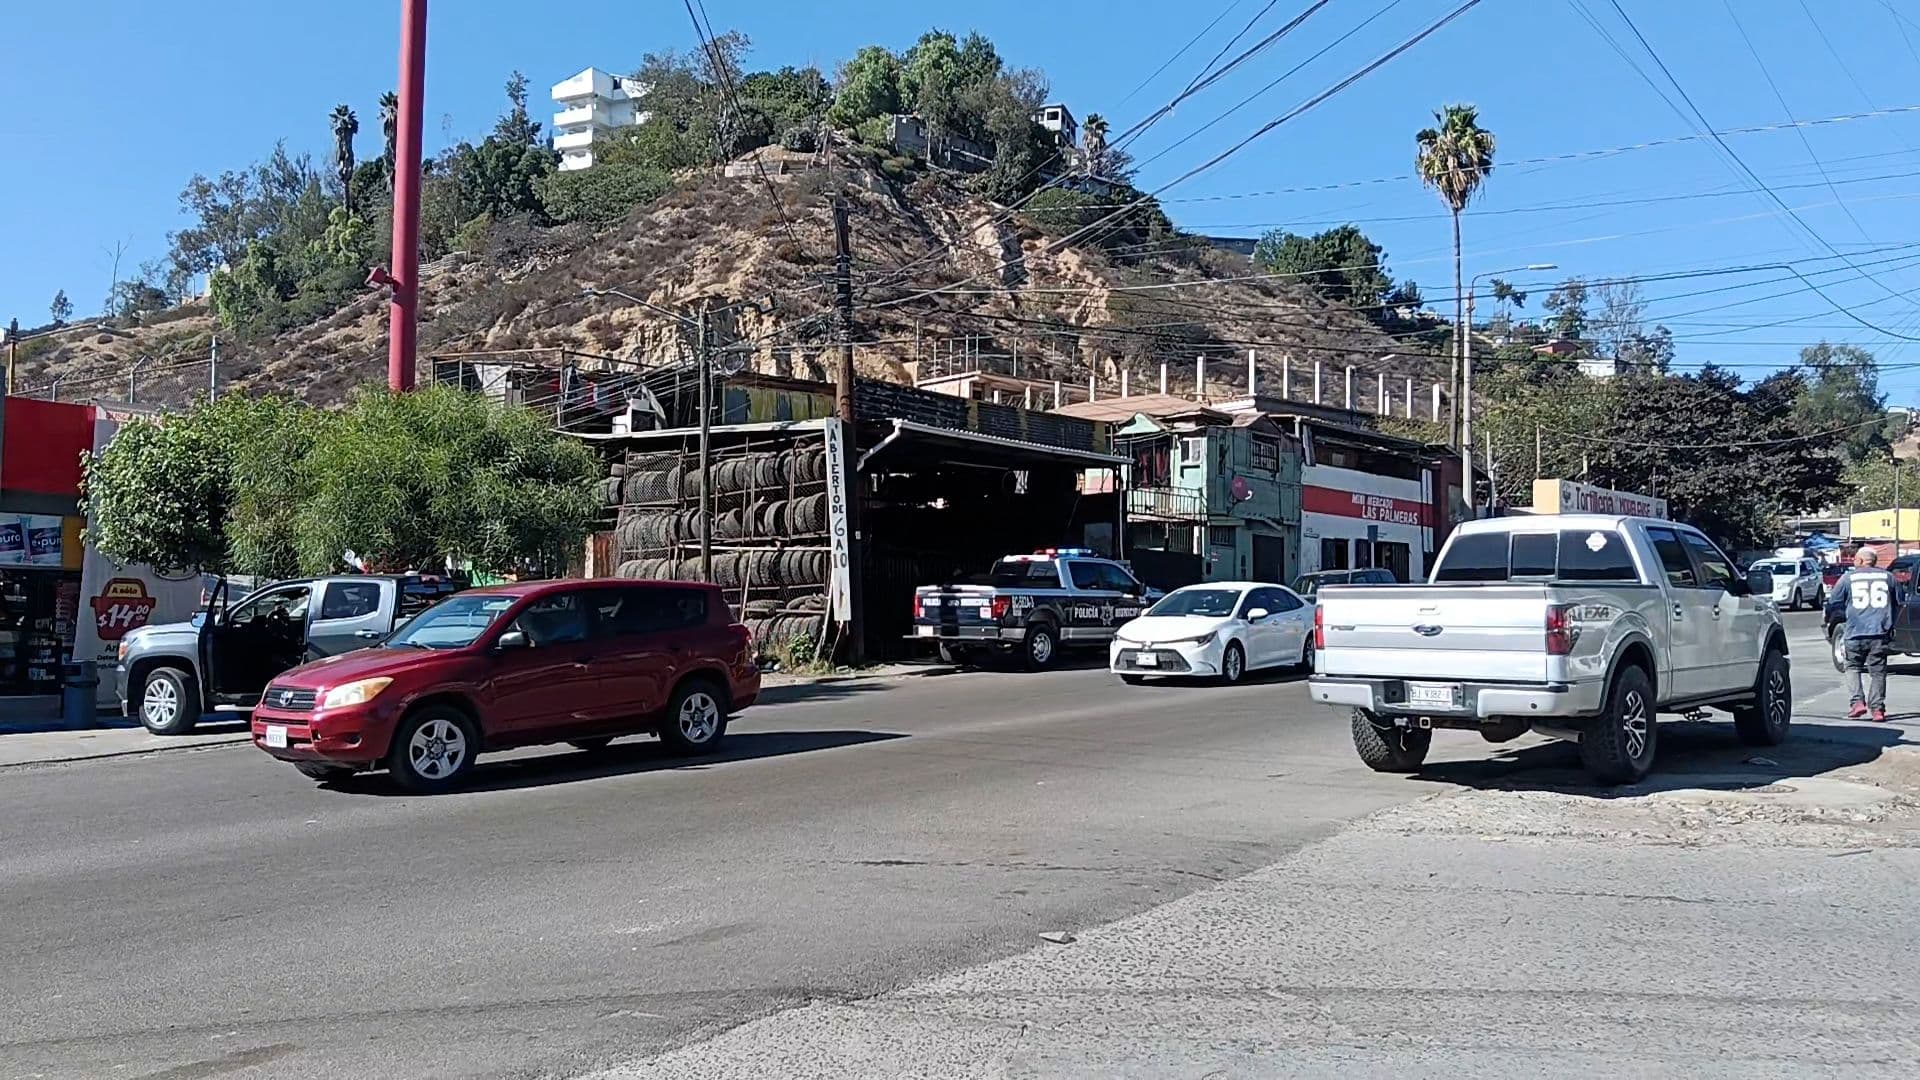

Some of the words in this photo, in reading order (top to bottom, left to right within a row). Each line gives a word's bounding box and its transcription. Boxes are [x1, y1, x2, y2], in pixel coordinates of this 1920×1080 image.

[832, 504, 844, 514] DE
[1367, 496, 1393, 509] MERCADO
[1362, 505, 1377, 520] LAS
[1380, 508, 1418, 525] PALMERAS
[834, 517, 845, 537] 6
[835, 539, 843, 550] A
[833, 553, 848, 568] 10
[1851, 581, 1888, 609] 56
[1585, 606, 1610, 619] FX4
